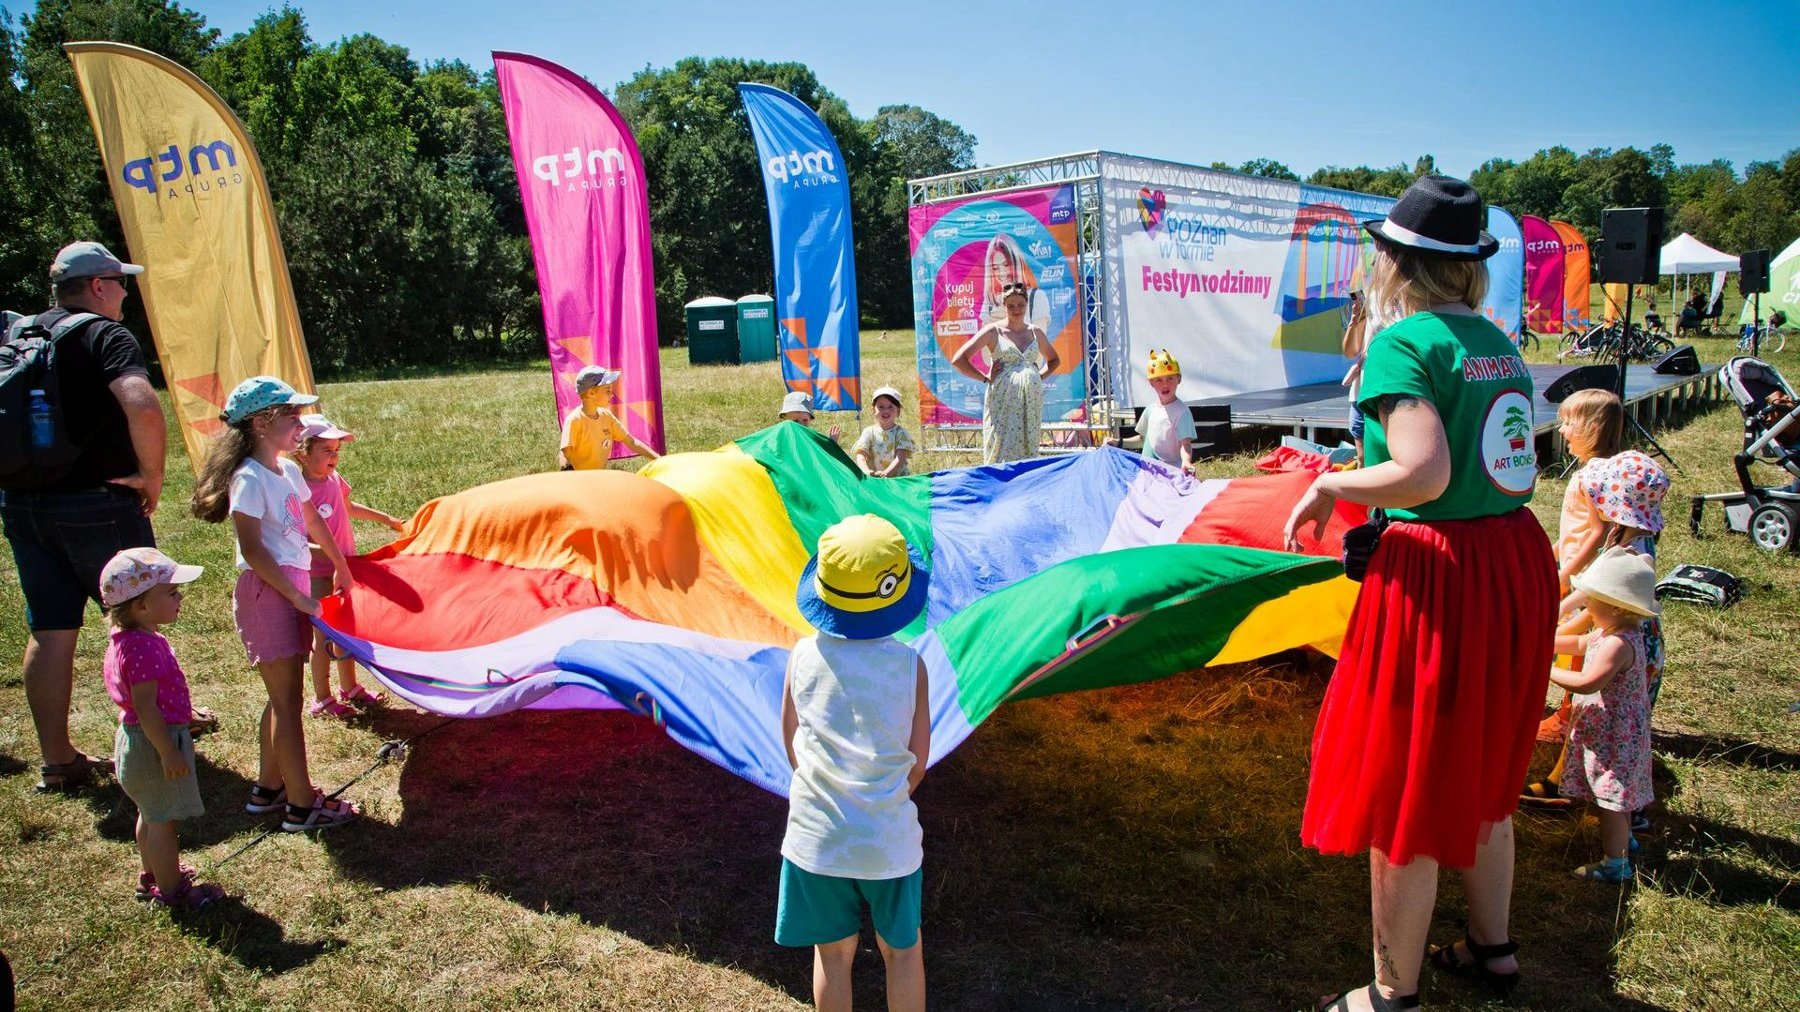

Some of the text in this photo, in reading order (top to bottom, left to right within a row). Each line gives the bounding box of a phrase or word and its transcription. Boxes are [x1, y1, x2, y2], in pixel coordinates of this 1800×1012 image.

[1052, 209, 1070, 218] mtp
[1160, 239, 1214, 262] w formie
[945, 281, 974, 295] Kupuj
[1142, 265, 1271, 299] Festyn rodzinny
[947, 296, 975, 309] bilety
[964, 309, 975, 318] na
[1494, 457, 1511, 470] ART
